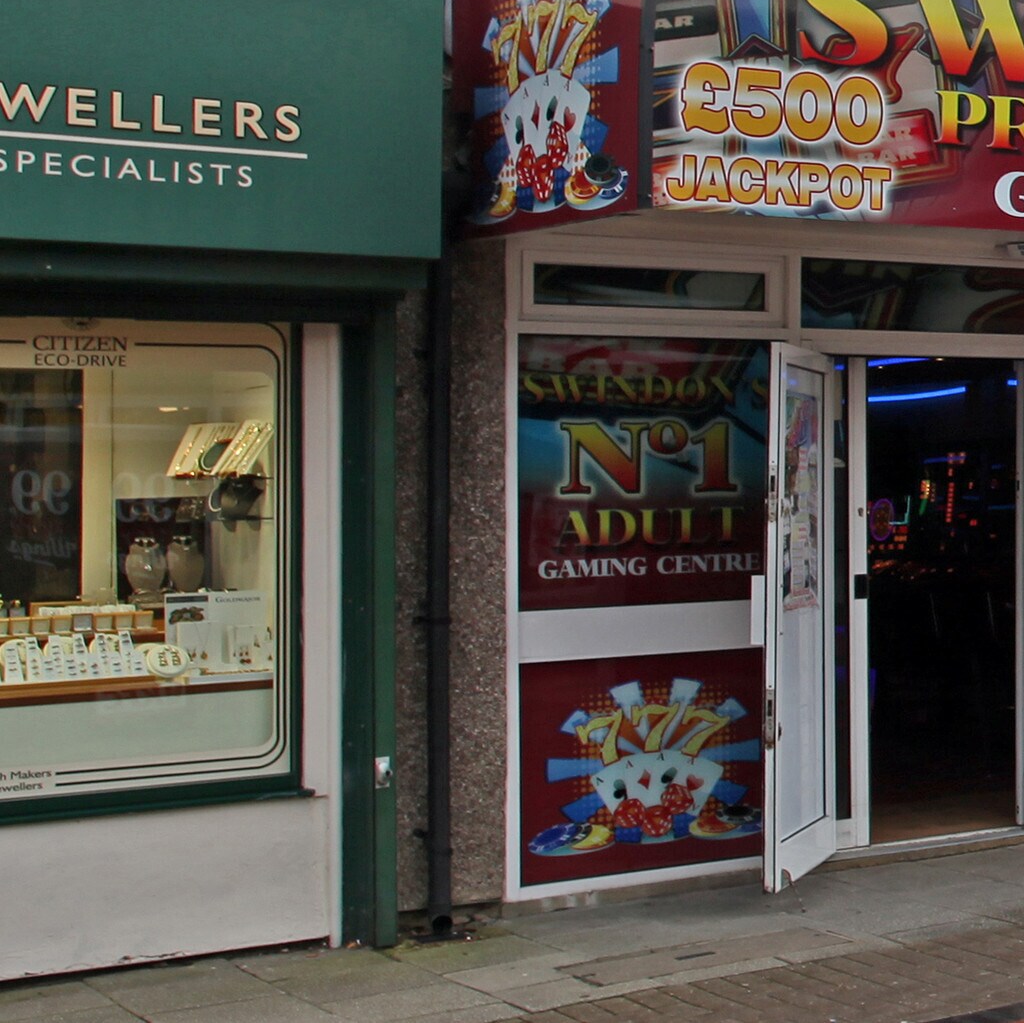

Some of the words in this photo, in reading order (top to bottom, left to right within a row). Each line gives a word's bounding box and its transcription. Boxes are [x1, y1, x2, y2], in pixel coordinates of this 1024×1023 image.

[655, 15, 694, 29] AR
[0, 83, 301, 142] WELLERS
[680, 62, 883, 145] £500
[667, 154, 892, 211] JACKPOT
[32, 335, 127, 352] CITIZEN
[34, 354, 127, 367] ECO-DRIVE
[556, 507, 742, 546] ADULT
[538, 558, 647, 579] GAMING
[657, 553, 759, 575] CENTRE
